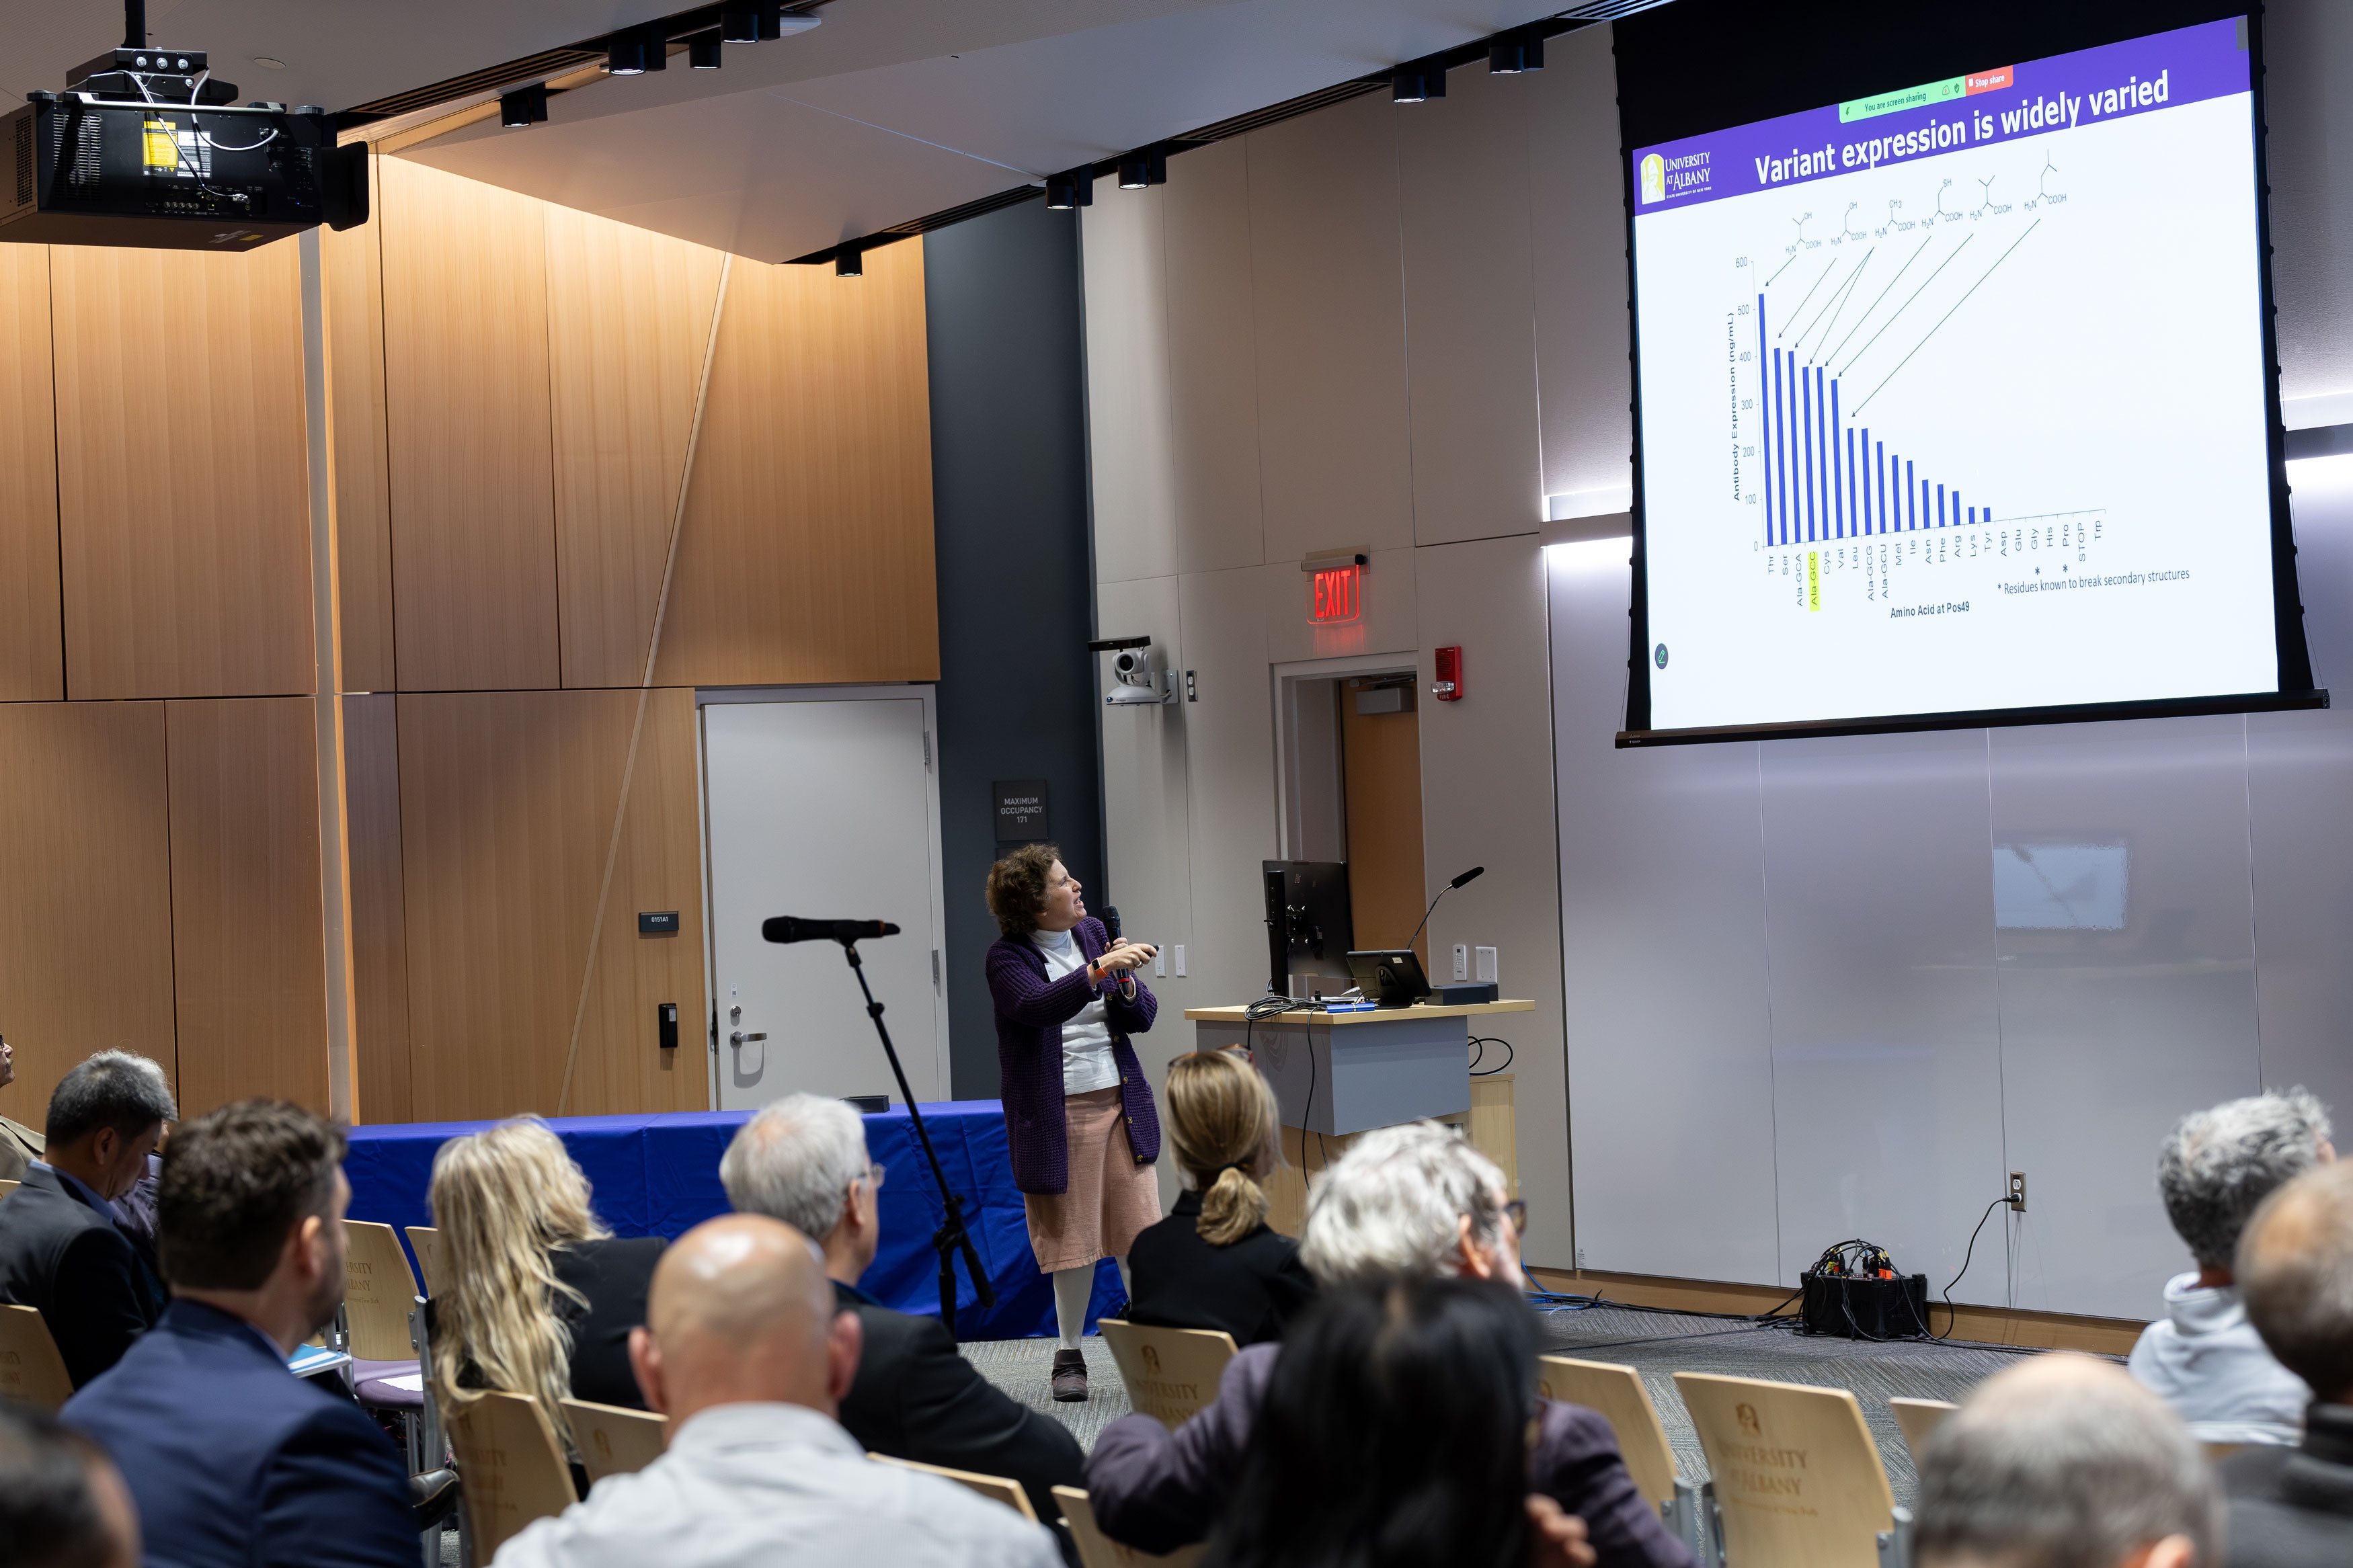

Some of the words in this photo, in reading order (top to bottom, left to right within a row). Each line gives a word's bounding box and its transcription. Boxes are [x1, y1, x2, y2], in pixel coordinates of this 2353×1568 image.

[1975, 78, 1988, 88] Stop
[1989, 73, 2005, 85] share
[1865, 102, 1875, 112] You
[1877, 101, 1886, 110] are
[1886, 97, 1905, 108] screen
[1905, 91, 1927, 105] sharing
[1755, 143, 1835, 185] Variant
[1841, 119, 1966, 169] expression
[1974, 110, 1994, 140] is
[2000, 91, 2081, 128] widely
[2088, 69, 2169, 116] varied
[1665, 151, 1710, 172] UNIVERSITY
[1666, 175, 1673, 185] AT
[1673, 167, 1711, 191] ALBANY
[1943, 179, 1952, 188] SH
[1889, 199, 1902, 208] CH3
[2048, 194, 2067, 204] COOH
[1849, 202, 1858, 210] OH
[1993, 204, 2011, 214] COOH
[1804, 212, 1812, 220] OH
[1945, 212, 1963, 222] COOH
[1898, 220, 1915, 231] COOH
[1851, 231, 1867, 241] COOH
[1806, 240, 1821, 249] COOH
[1736, 256, 1747, 268] 600
[1738, 304, 1749, 316] 500
[1727, 313, 1736, 362] (ng/mL)
[1739, 351, 1751, 362] 400
[1730, 366, 1739, 439] Expression
[1741, 399, 1753, 410] 300
[1743, 446, 1755, 457] 200
[1745, 493, 1756, 505] 100
[2094, 520, 2102, 542] Trp
[2031, 528, 2039, 550] Gly
[2077, 522, 2085, 562] STOP
[1753, 540, 1758, 551] 0
[1866, 545, 1874, 601] Ala-GCG
[1880, 544, 1888, 599] Ala-GCU
[1795, 553, 1803, 606] Ala-GCA
[1808, 551, 1817, 605] Ala-GCC
[2004, 581, 2038, 595] Residues
[2040, 579, 2067, 592] known
[2069, 577, 2077, 589] to
[2079, 574, 2102, 588] break
[2104, 571, 2145, 585] secondary
[2147, 568, 2190, 583] structures
[1314, 569, 1351, 618] EXIT
[1890, 606, 1915, 618] Amino
[1917, 604, 1935, 616] Acid
[1937, 604, 1945, 614] at
[1947, 601, 1970, 614] Pos49
[1004, 797, 1038, 805] MAXIMUM
[1000, 806, 1043, 815] OCCUPANCY
